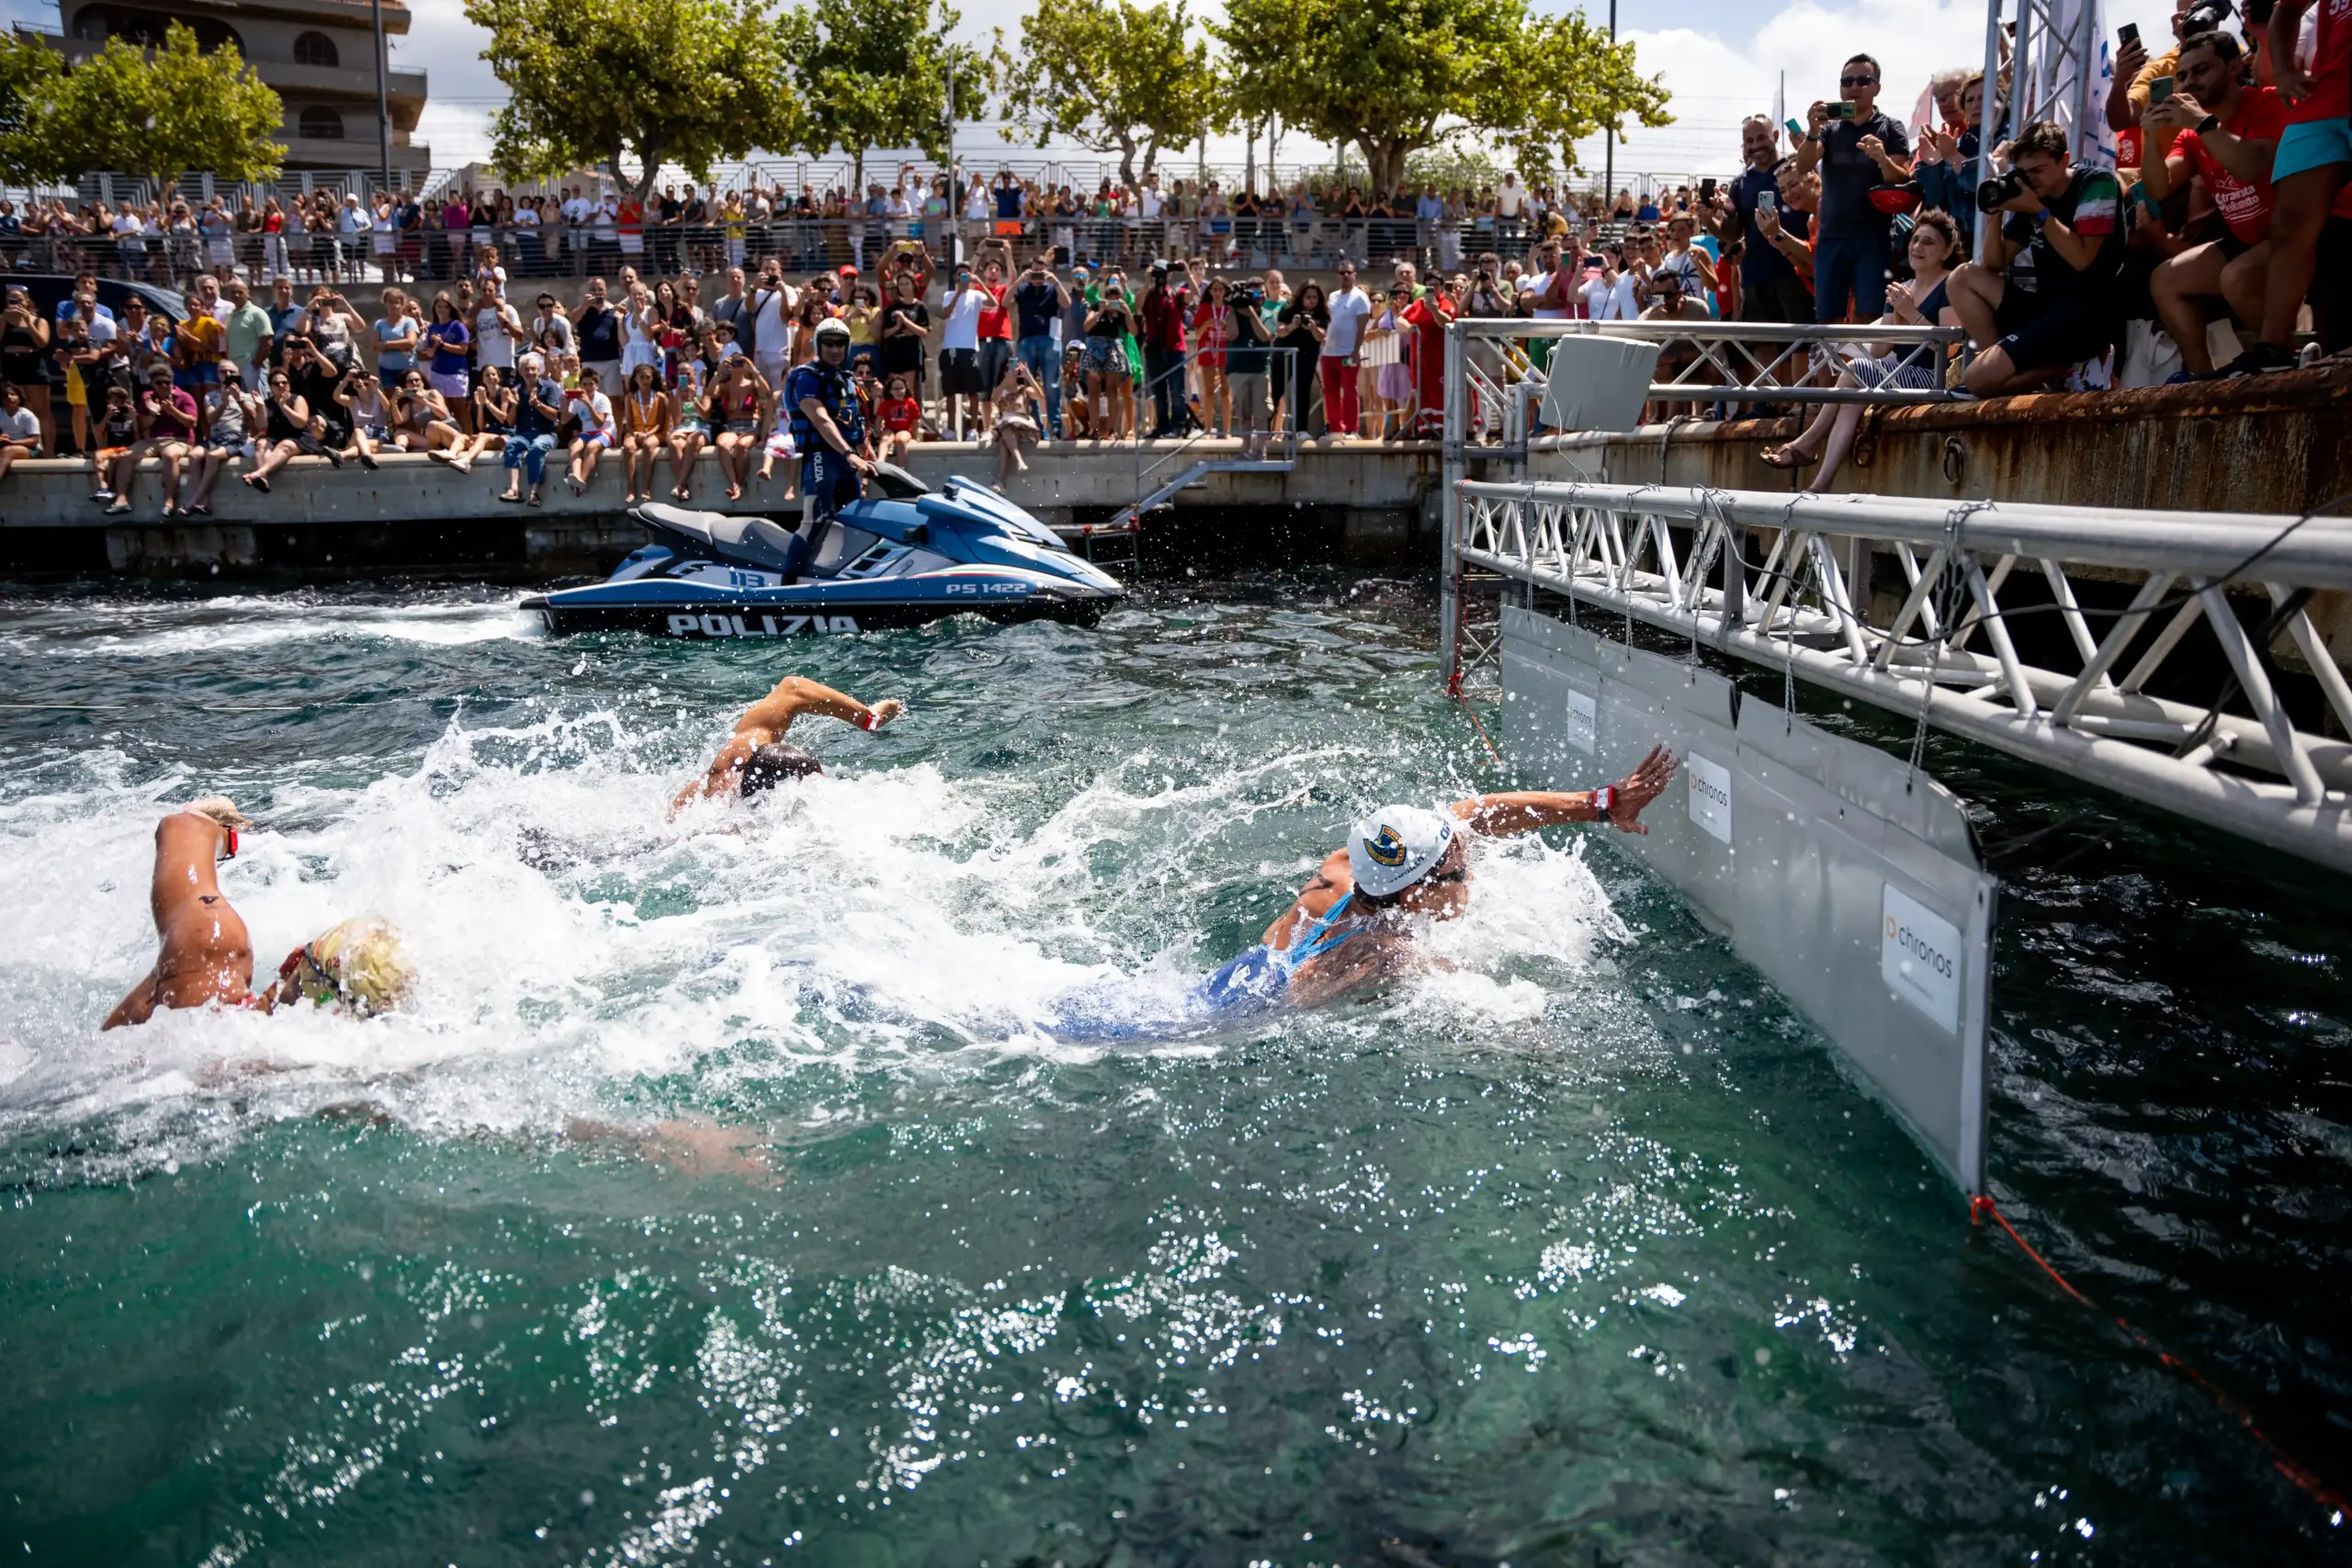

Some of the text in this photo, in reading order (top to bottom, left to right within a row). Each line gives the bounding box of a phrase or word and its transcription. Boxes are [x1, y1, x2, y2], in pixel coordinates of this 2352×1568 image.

[729, 571, 764, 588] 113
[945, 582, 1027, 594] PS 1422
[667, 615, 861, 637] POLIZIA
[1572, 705, 1592, 728] chronos
[1697, 776, 1727, 807] chronos
[1898, 925, 1952, 979] chronos
